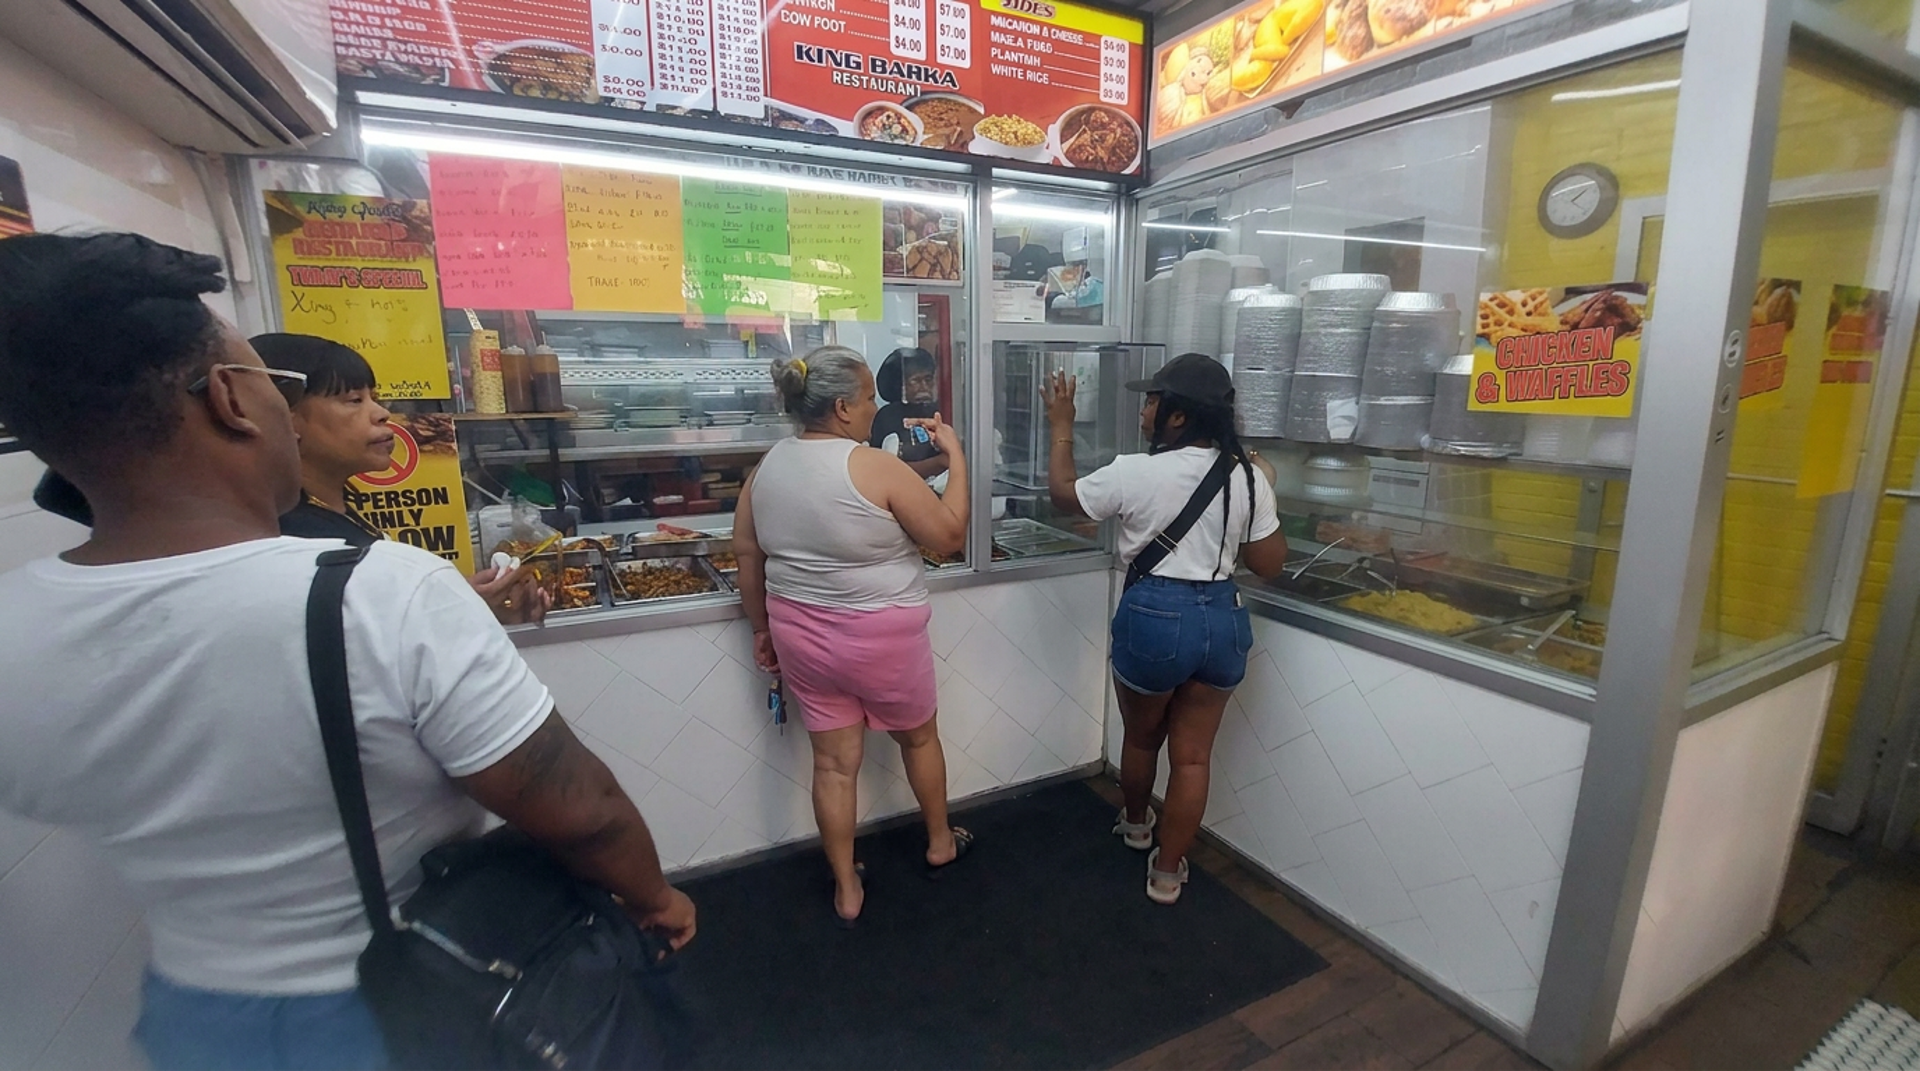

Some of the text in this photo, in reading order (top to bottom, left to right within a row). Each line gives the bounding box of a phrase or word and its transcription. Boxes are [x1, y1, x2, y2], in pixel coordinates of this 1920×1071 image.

[939, 23, 967, 40] $7.00
[794, 42, 864, 73] KING
[990, 63, 1025, 80] WHITE
[832, 70, 922, 98] RESTAURANT
[1496, 326, 1615, 369] CHICKEN
[1475, 361, 1631, 404] & WAFFLES
[355, 486, 450, 511] PERSON
